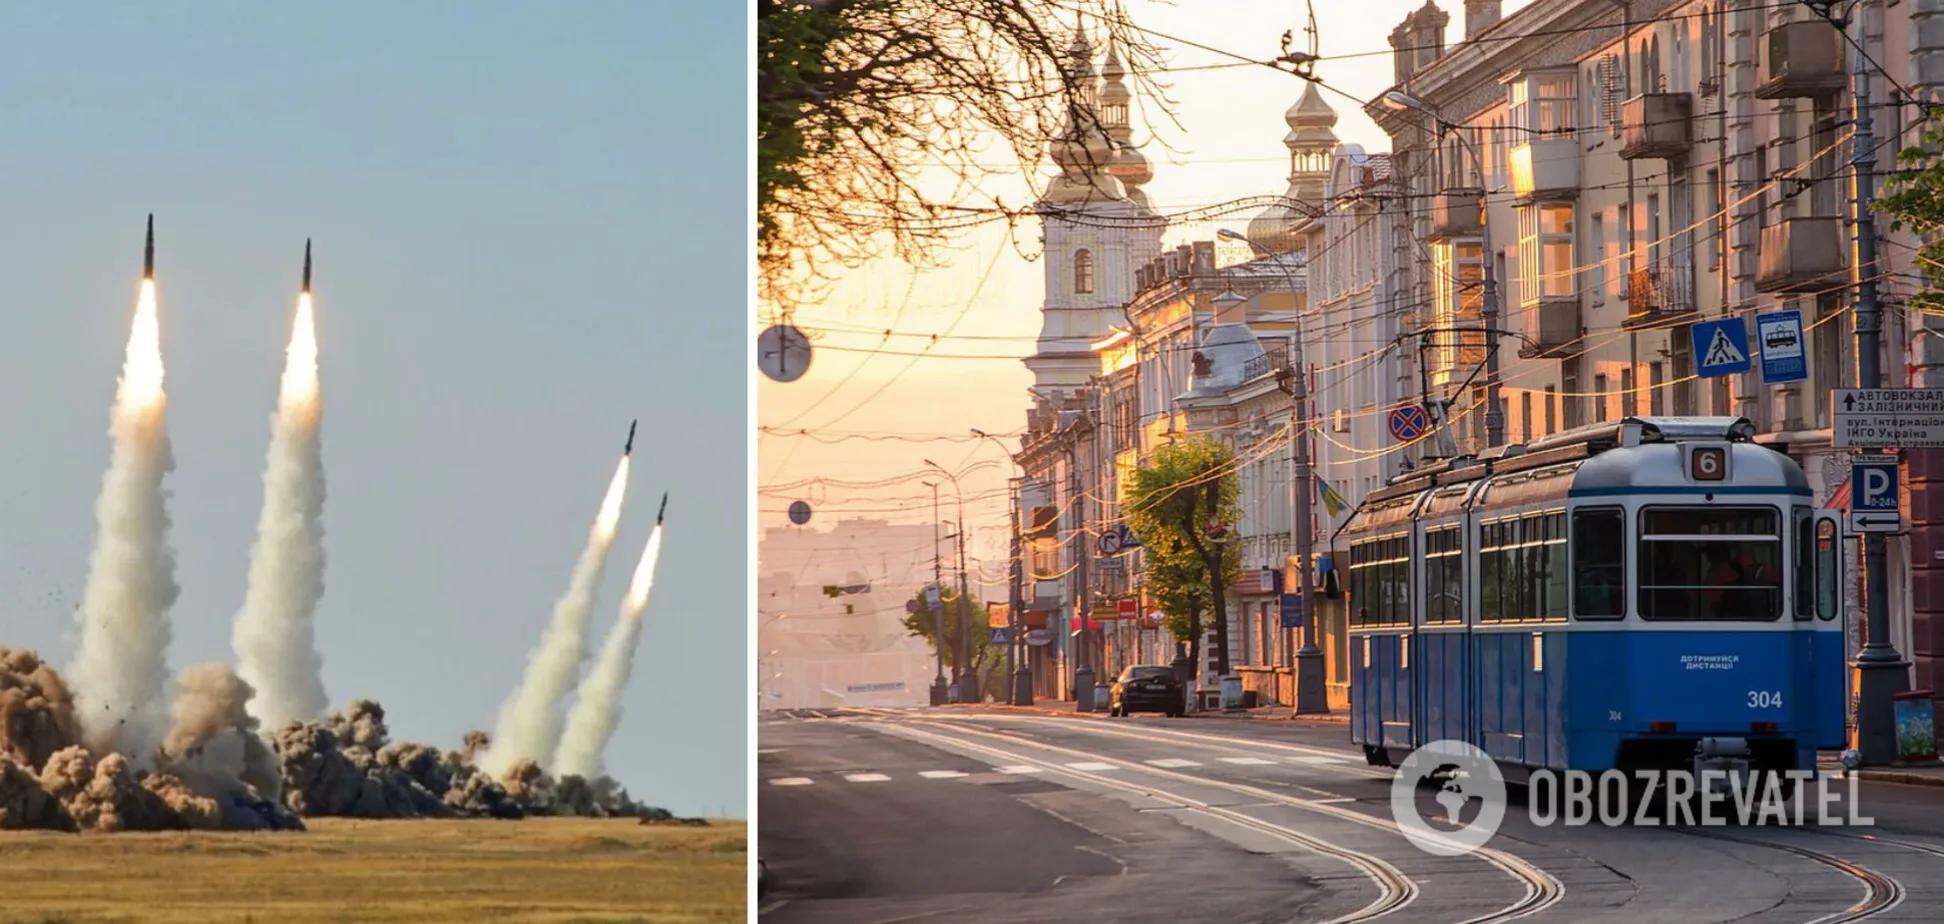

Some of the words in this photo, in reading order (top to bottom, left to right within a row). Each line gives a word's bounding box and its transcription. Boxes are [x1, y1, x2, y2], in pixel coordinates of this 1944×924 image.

[1858, 391, 1943, 401] АВТОВОКЗАЛ
[1847, 418, 1871, 428] вул.
[1847, 428, 1875, 438] ІНГО
[1700, 452, 1717, 473] 6
[1863, 468, 1890, 506] P
[1747, 690, 1783, 708] 304
